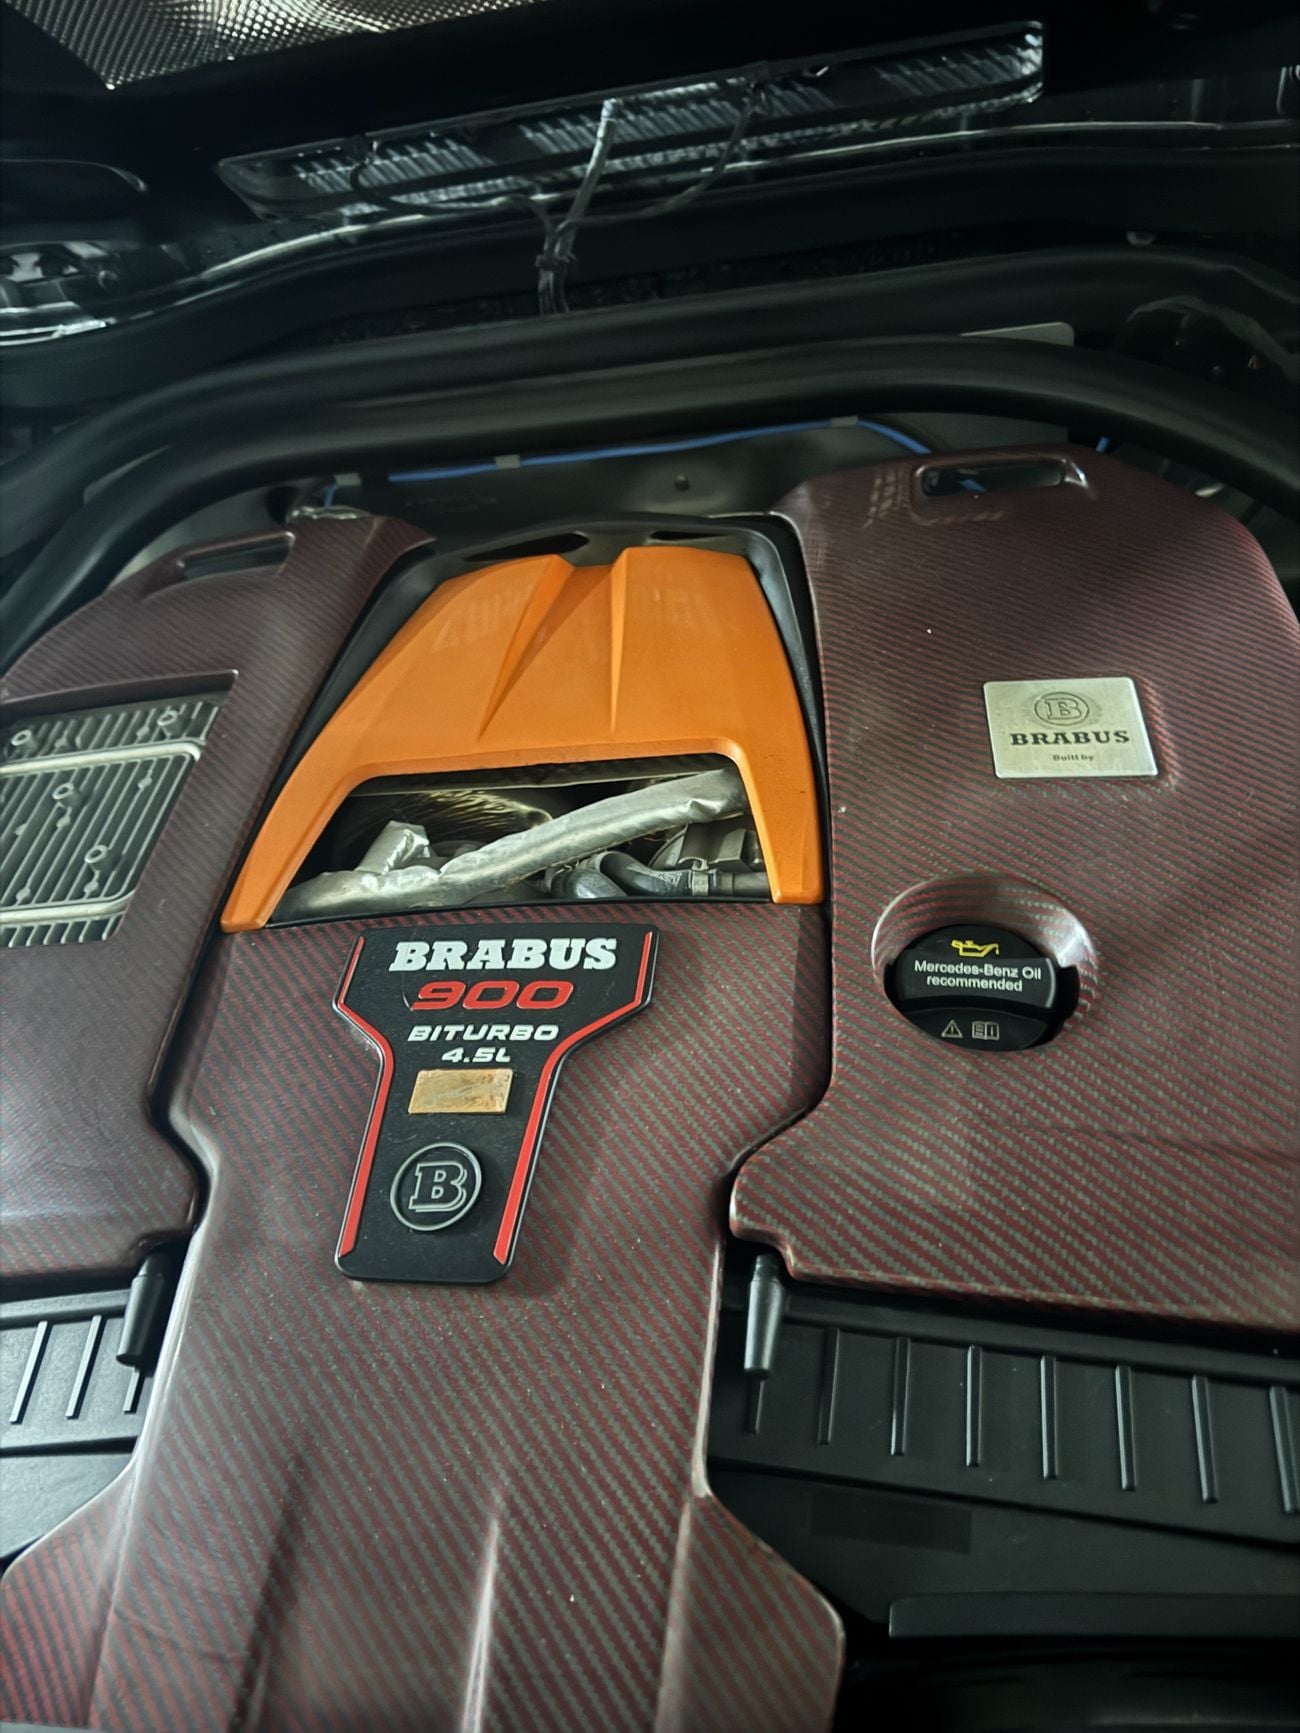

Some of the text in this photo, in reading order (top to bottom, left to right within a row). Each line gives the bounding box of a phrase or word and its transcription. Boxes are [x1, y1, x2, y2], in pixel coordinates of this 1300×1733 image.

[1010, 730, 1130, 745] BRABUS
[389, 938, 617, 972] BRABUS
[914, 960, 1041, 980] Mercedes-Benz Oil
[927, 976, 1022, 992] recommended
[410, 980, 574, 1011] 900
[407, 1025, 559, 1042] BITURBO
[442, 1047, 511, 1063] 4.5L
[408, 1161, 468, 1213] B
